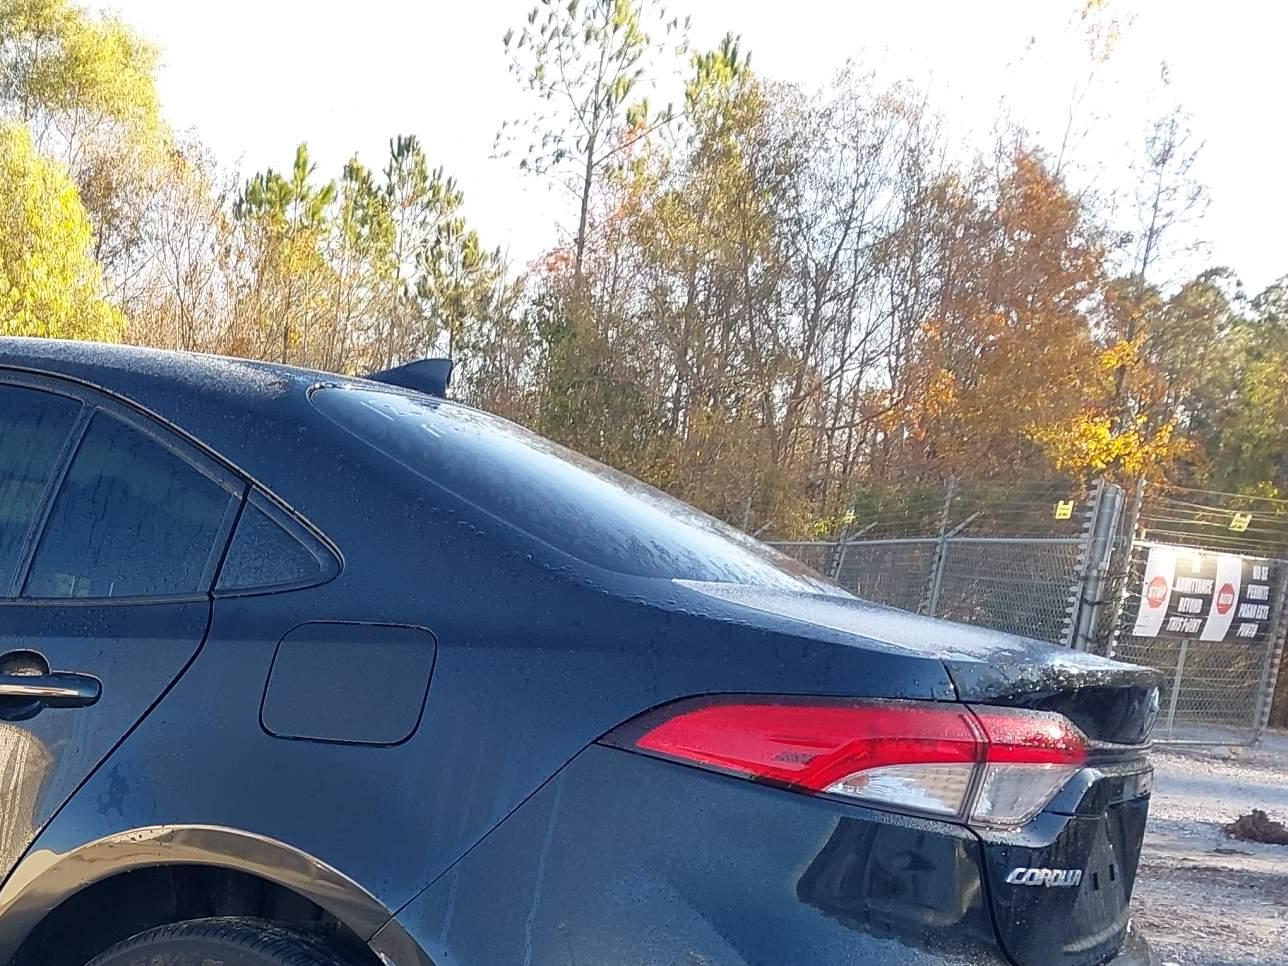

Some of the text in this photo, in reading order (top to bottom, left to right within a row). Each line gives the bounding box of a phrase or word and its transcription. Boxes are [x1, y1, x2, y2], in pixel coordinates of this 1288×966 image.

[1178, 597, 1203, 613] BEYOND
[1166, 617, 1202, 633] THIS POINT
[1006, 867, 1082, 888] COROLLA
